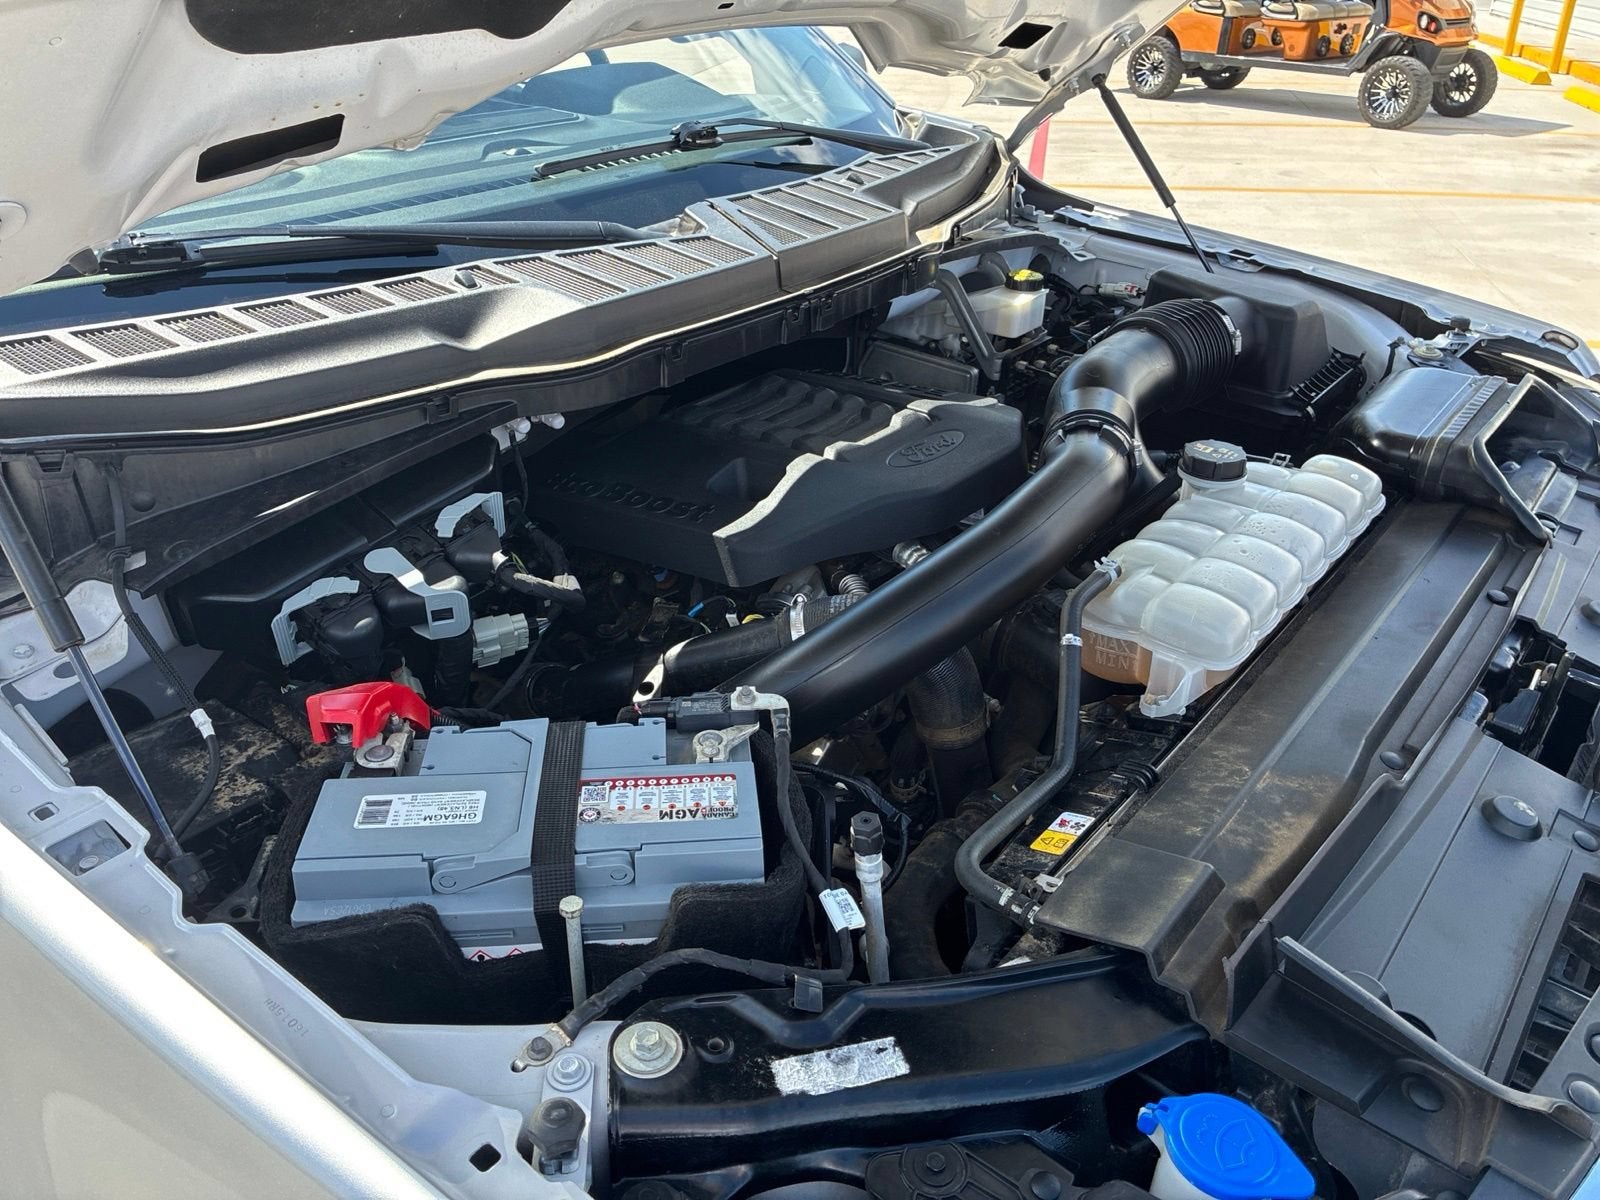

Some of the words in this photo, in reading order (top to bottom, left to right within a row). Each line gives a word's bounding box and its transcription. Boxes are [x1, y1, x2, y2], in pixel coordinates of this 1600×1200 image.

[900, 434, 957, 463] Ford
[1095, 634, 1131, 654] MAX
[1095, 651, 1130, 670] MIN
[423, 812, 477, 822] GH6AGM
[659, 808, 700, 821] AGM
